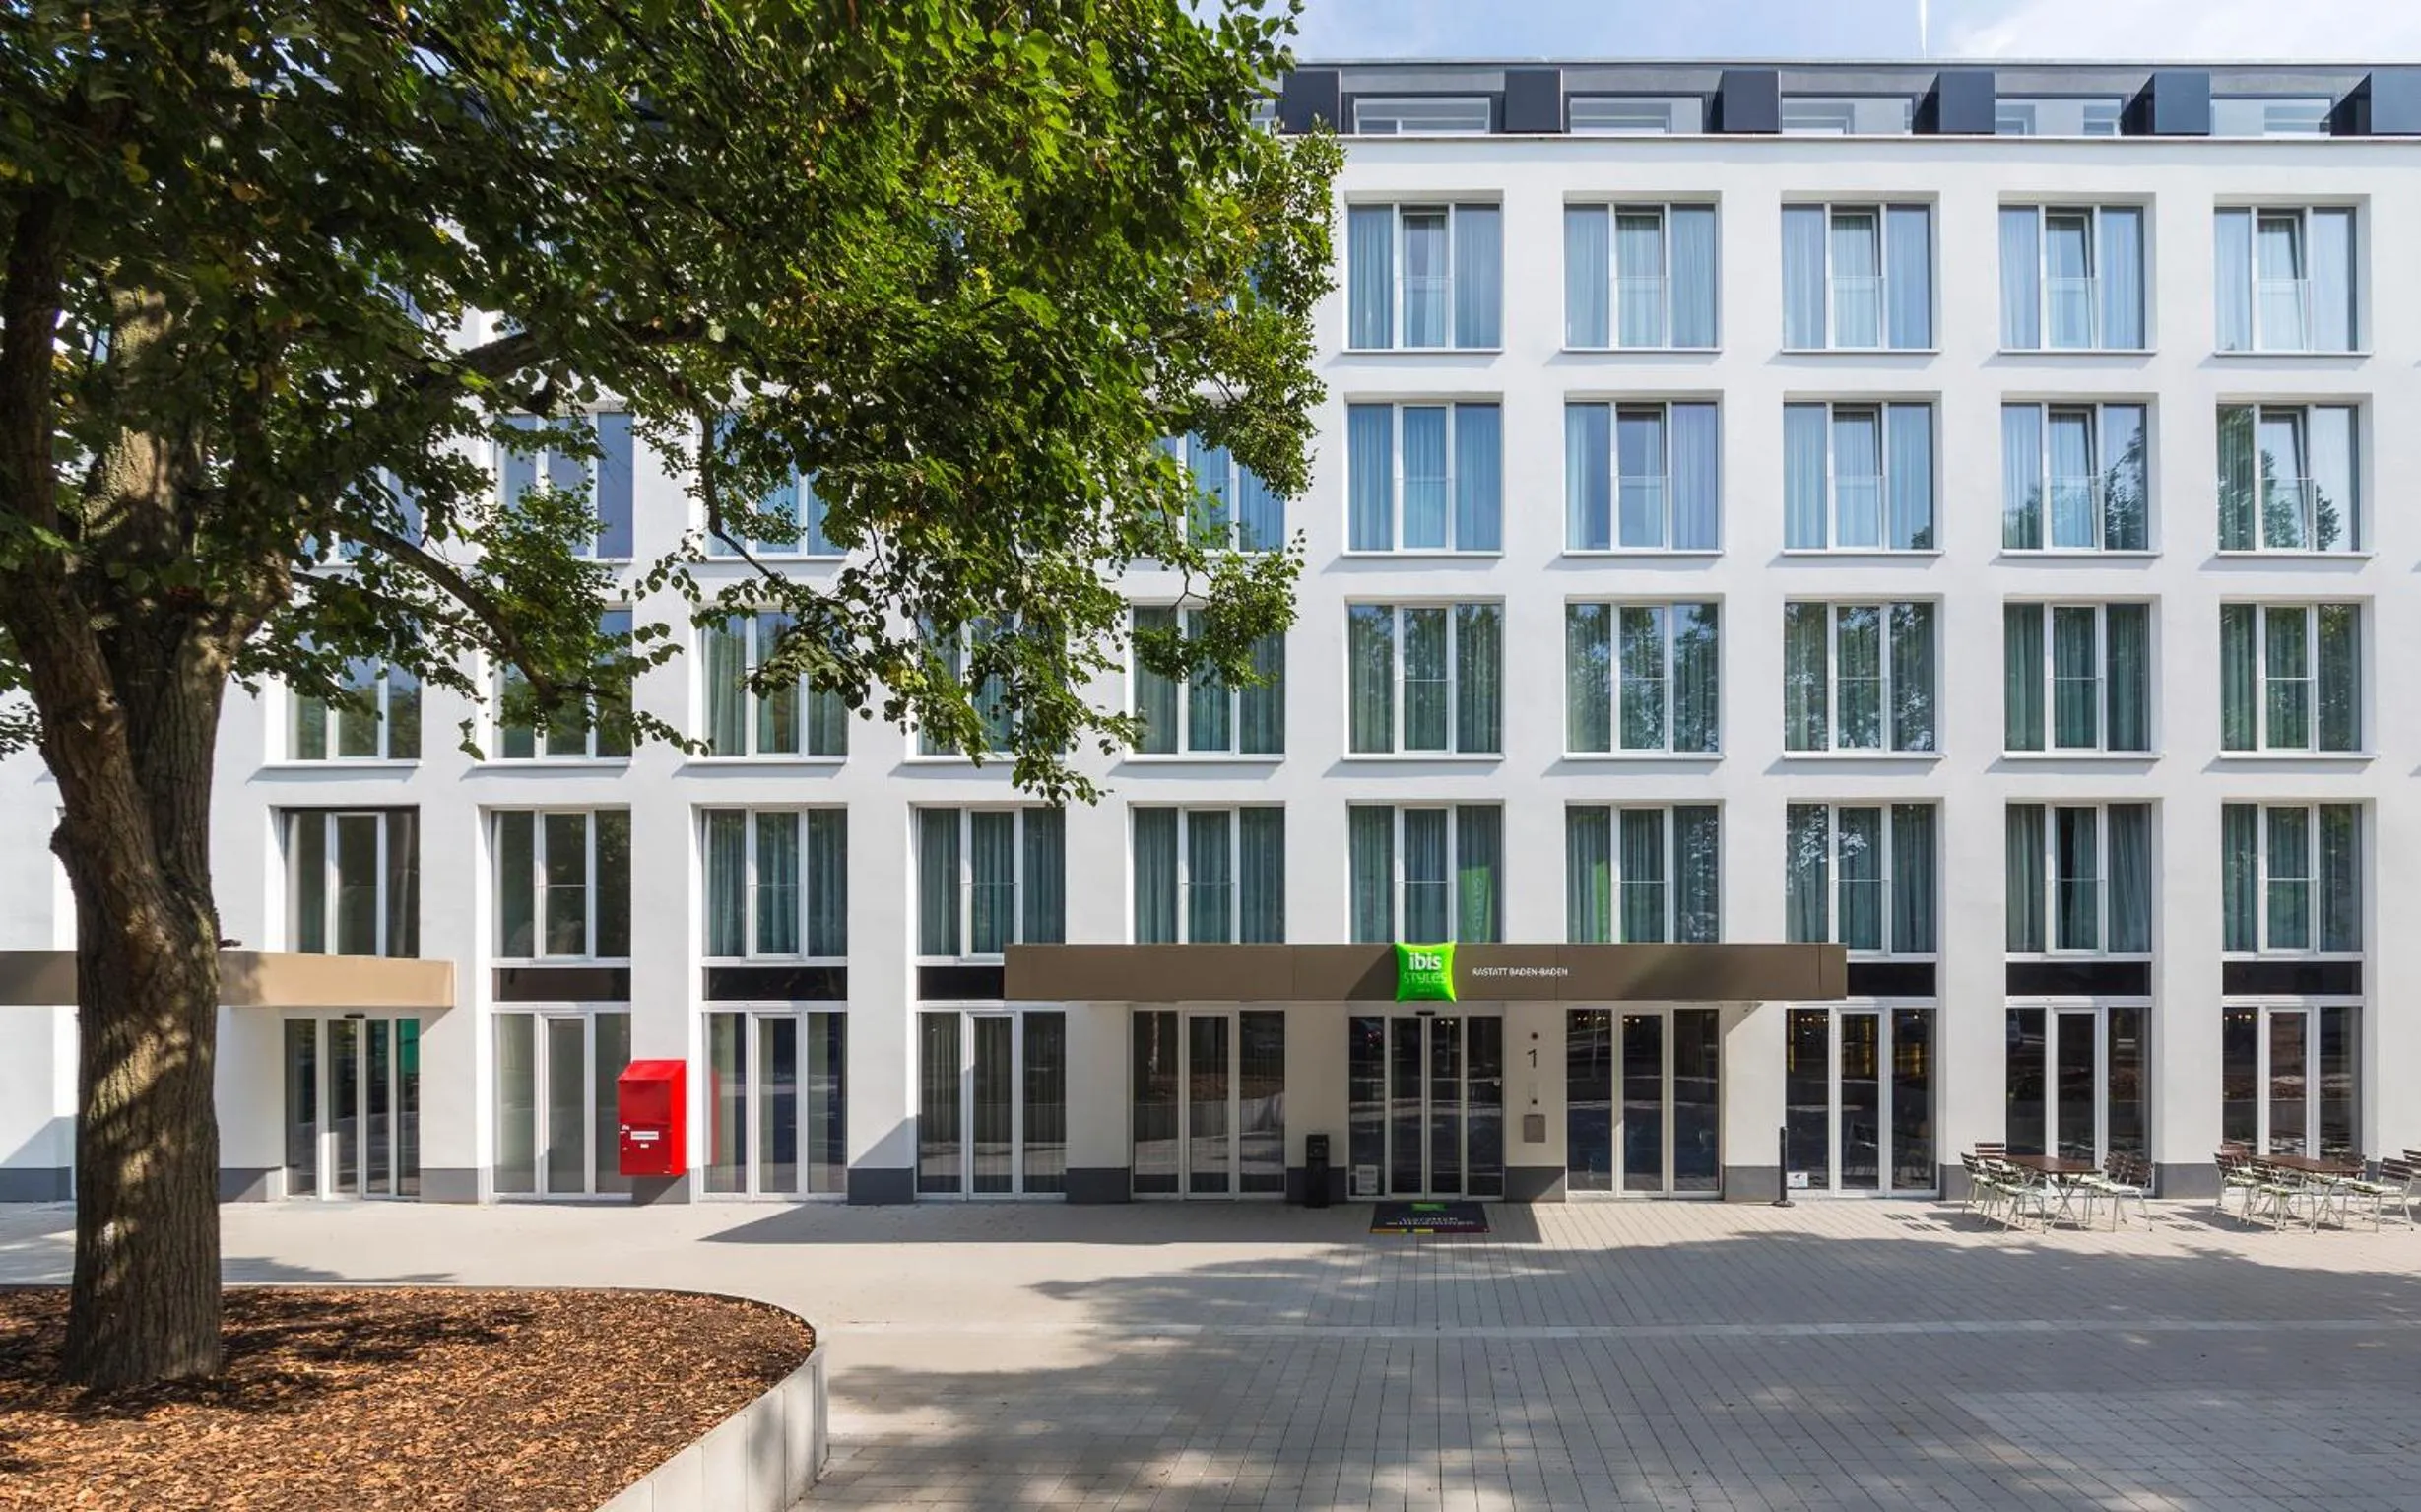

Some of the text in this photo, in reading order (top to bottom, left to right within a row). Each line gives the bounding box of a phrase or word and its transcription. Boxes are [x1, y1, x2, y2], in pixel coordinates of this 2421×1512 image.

[1408, 952, 1442, 970] ibis
[1472, 967, 1569, 977] RASTATT BADEN-BADEN
[1527, 1048, 1538, 1069] 1
